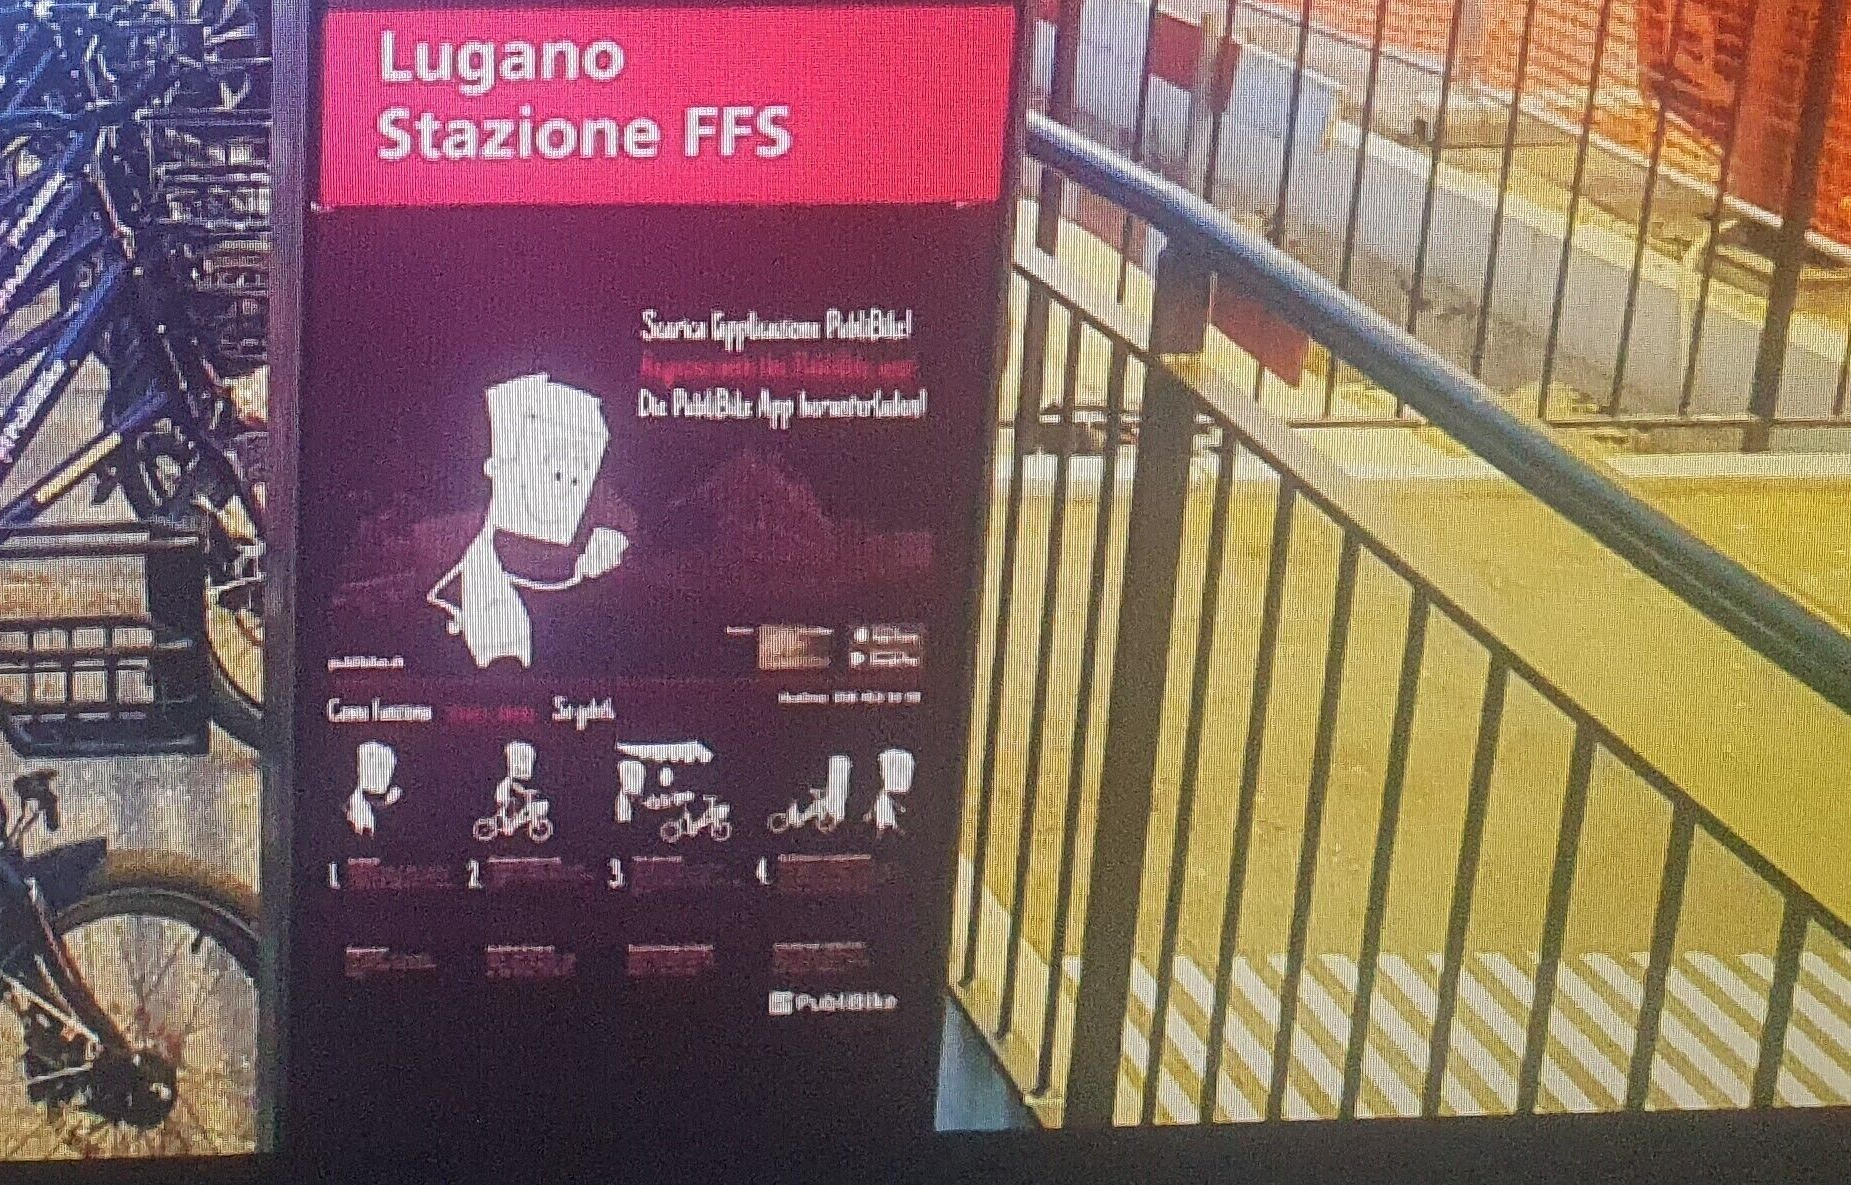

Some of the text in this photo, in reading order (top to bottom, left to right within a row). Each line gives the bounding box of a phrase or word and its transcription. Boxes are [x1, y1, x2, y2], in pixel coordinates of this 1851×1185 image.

[379, 30, 626, 96] Lugano
[377, 104, 793, 161] Stazione FFS
[466, 859, 484, 889] 2
[607, 858, 625, 888] 3
